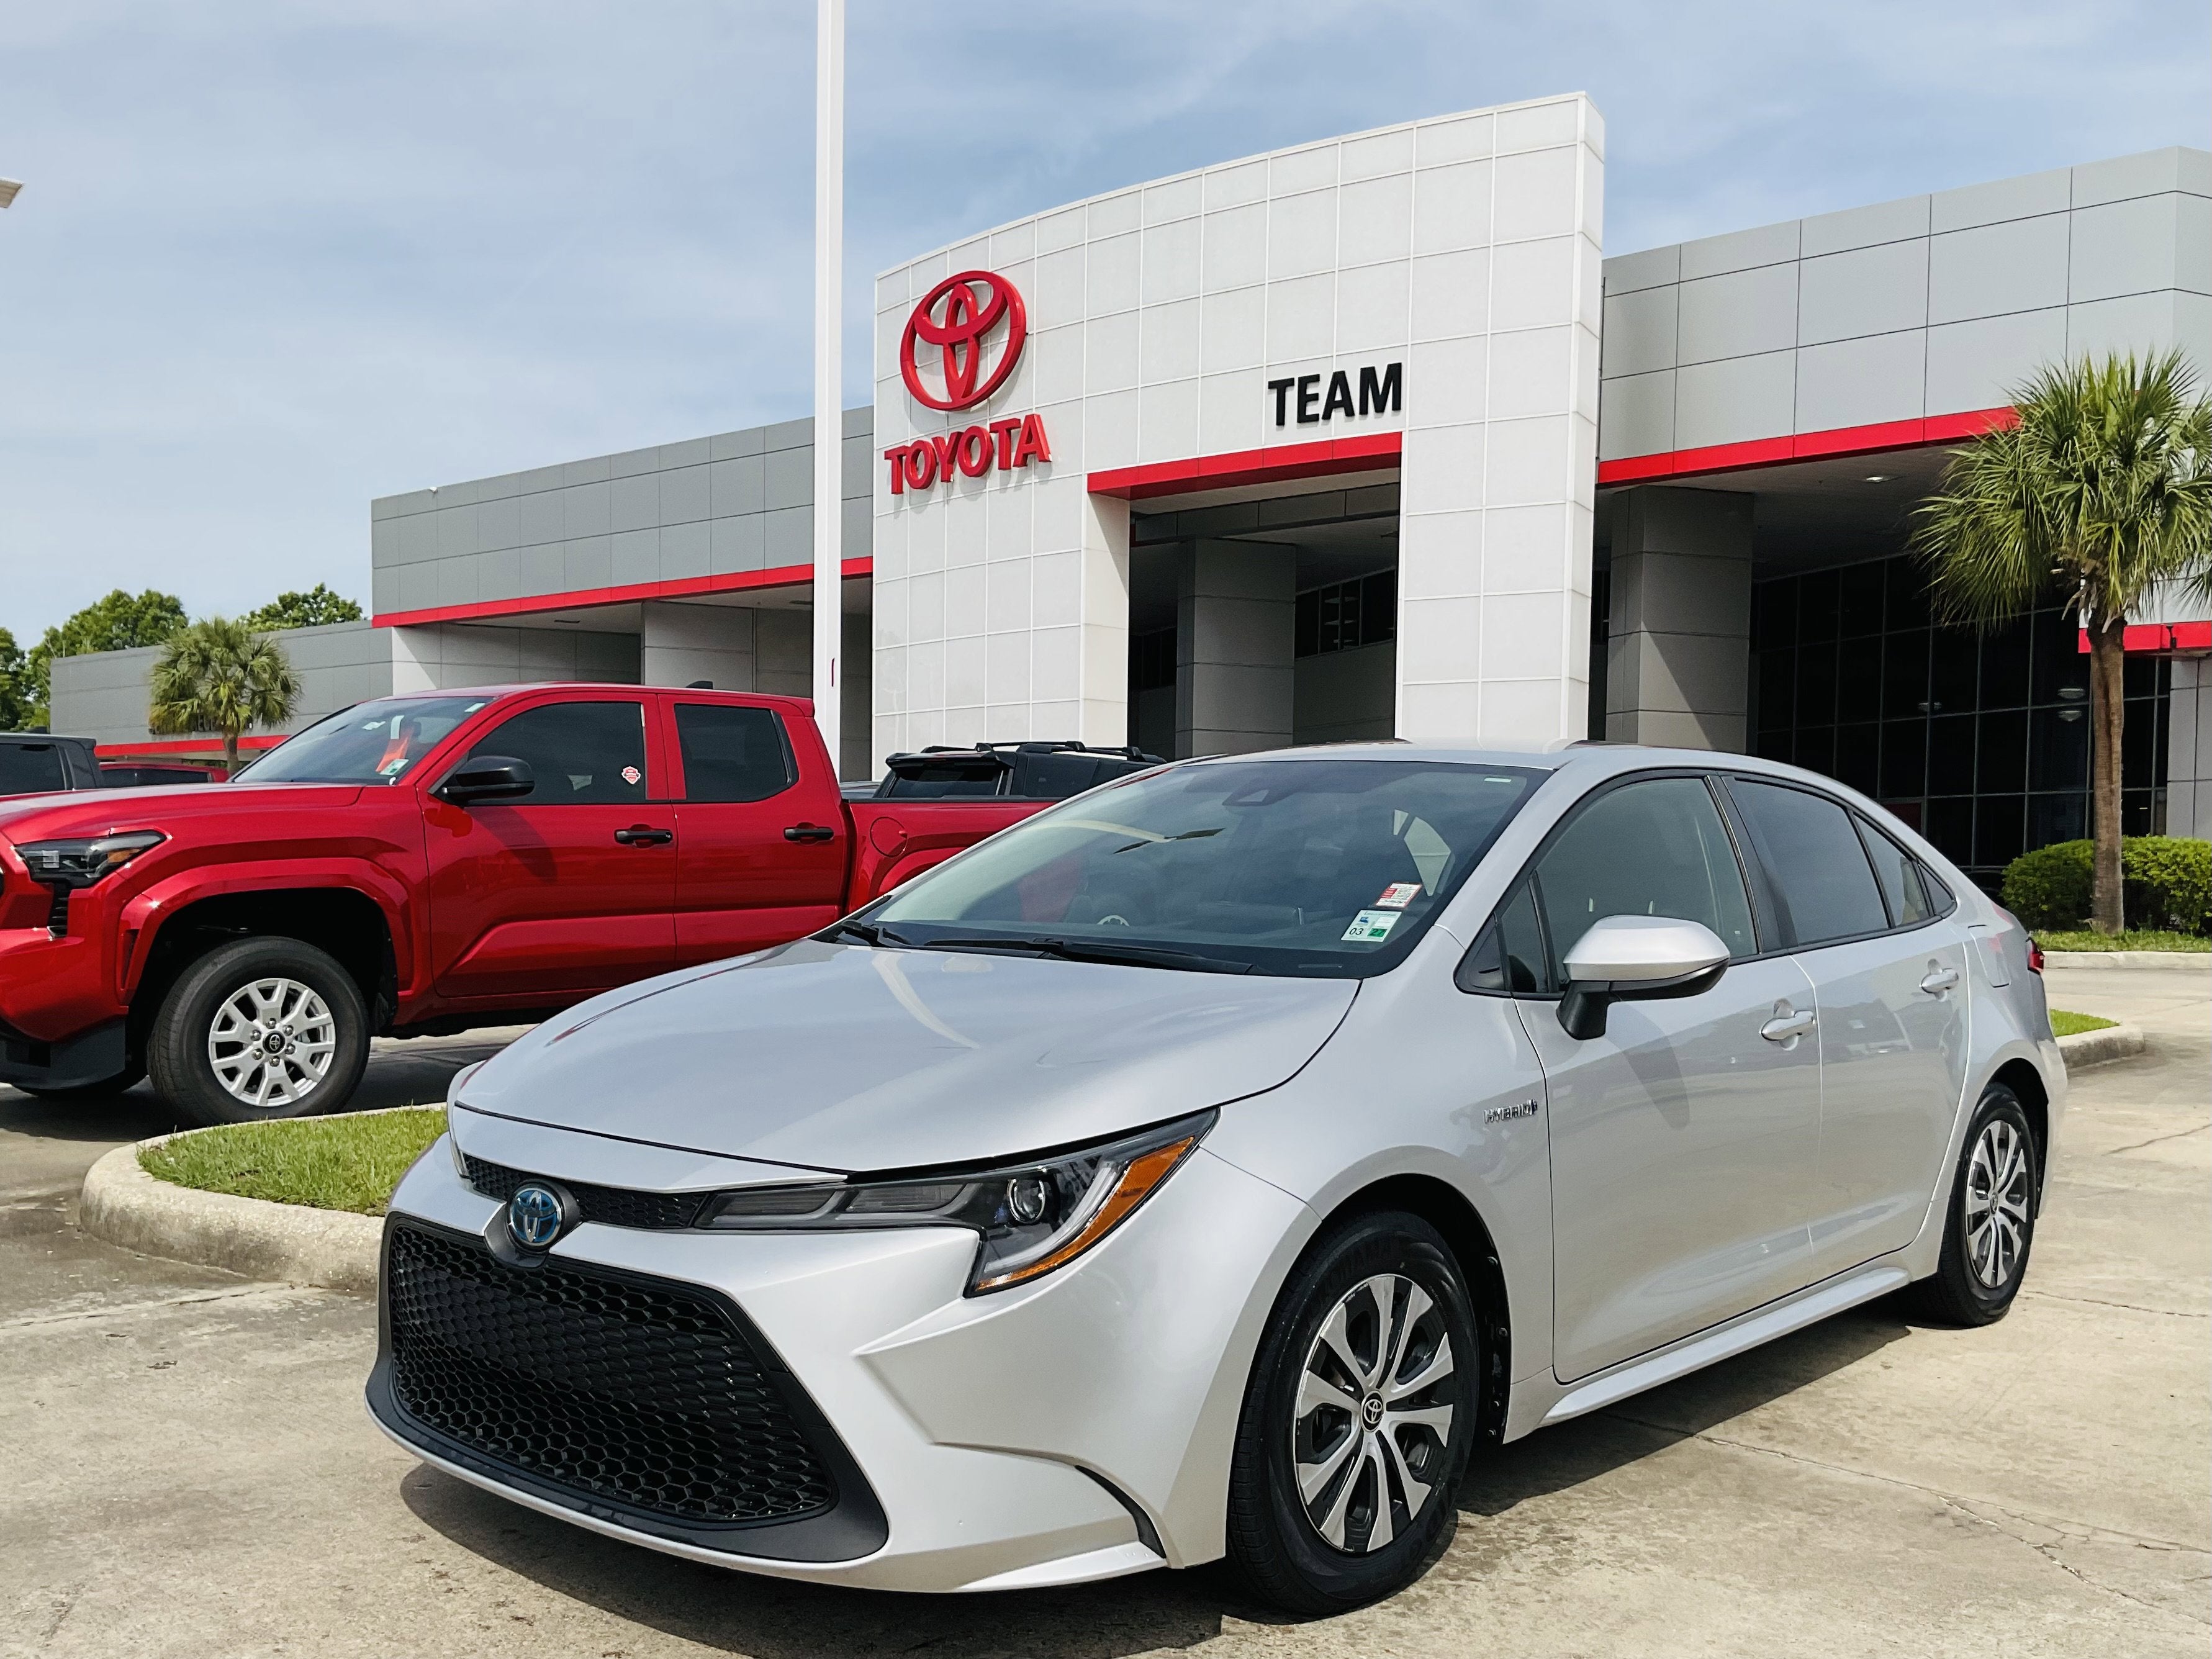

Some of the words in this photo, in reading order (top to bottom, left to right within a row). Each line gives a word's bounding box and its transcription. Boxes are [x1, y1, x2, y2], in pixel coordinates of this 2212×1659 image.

[1268, 362, 1402, 427] TEAM
[884, 414, 1052, 495] TOYOTA
[1484, 1100, 1535, 1124] HYBRID
